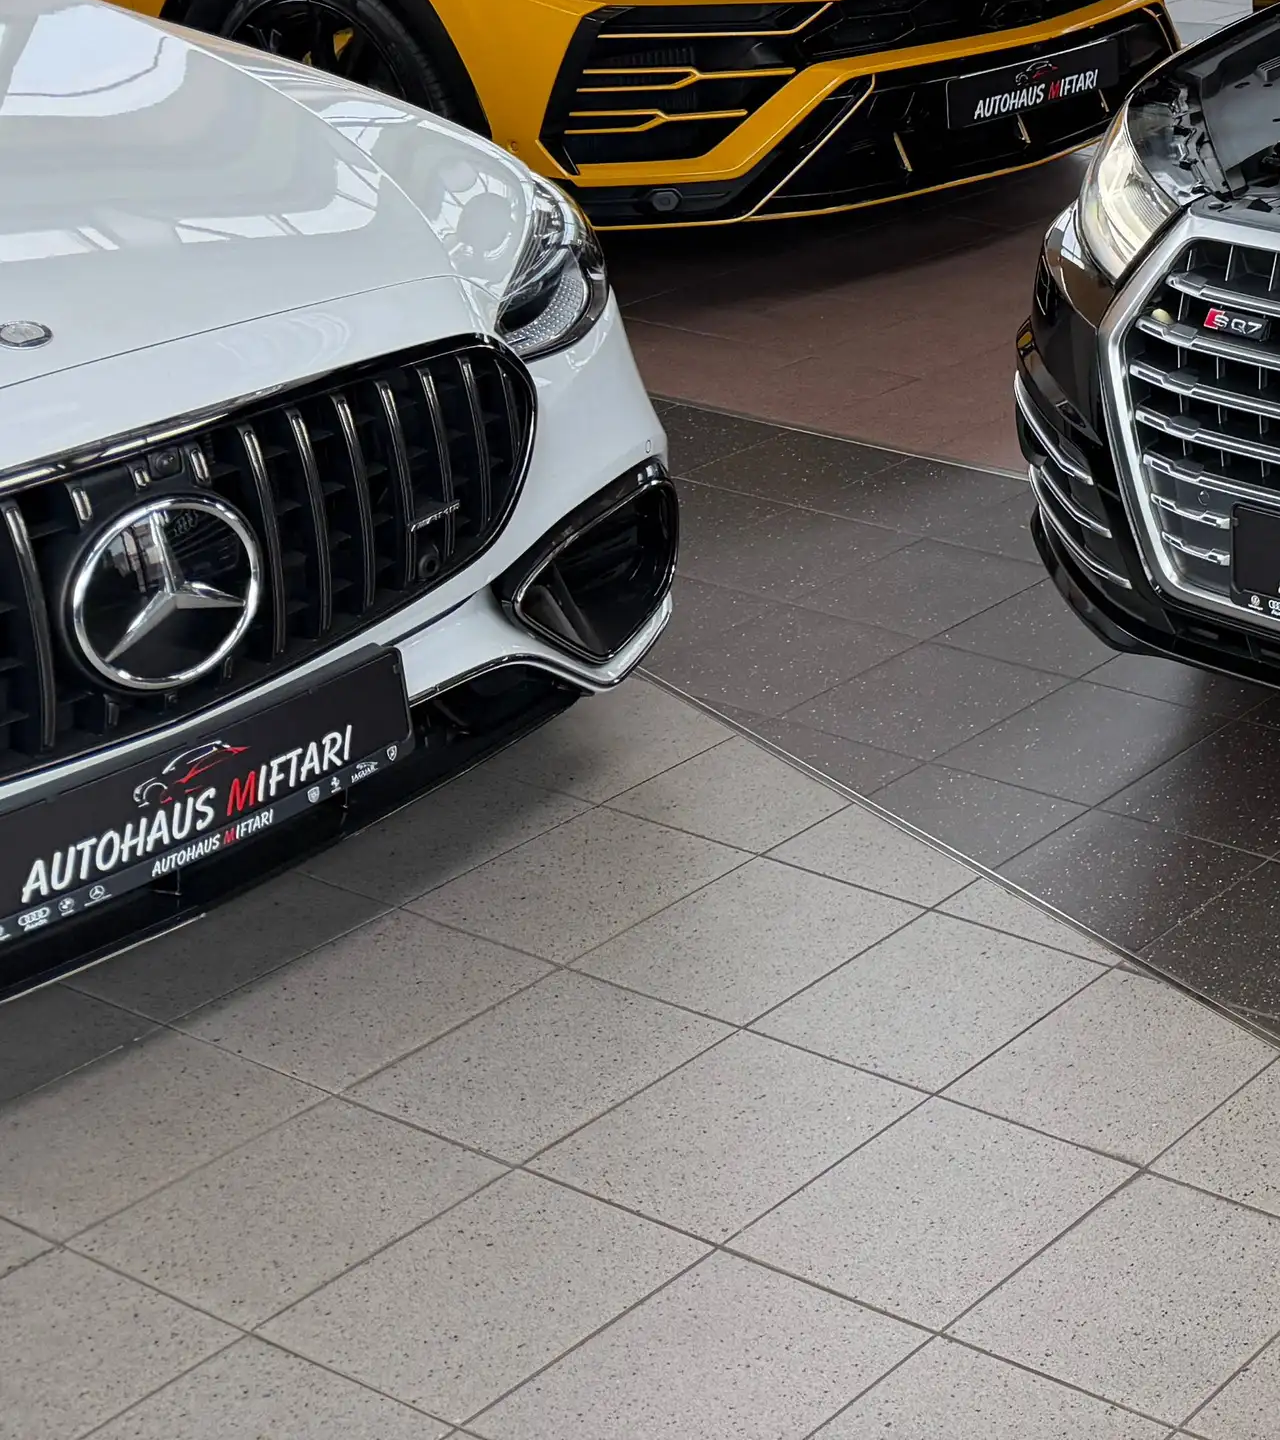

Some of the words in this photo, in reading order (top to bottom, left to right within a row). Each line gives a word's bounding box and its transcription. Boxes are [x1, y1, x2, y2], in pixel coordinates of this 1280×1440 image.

[973, 83, 1046, 120] AUTOHAUS
[1047, 69, 1099, 101] MIFTARI
[1213, 313, 1263, 335] SQ7
[20, 787, 217, 904] AUTOHAUS
[226, 724, 353, 817] MIFTARI
[151, 833, 221, 878] AUTOHAUS
[222, 808, 275, 846] MIFTARI
